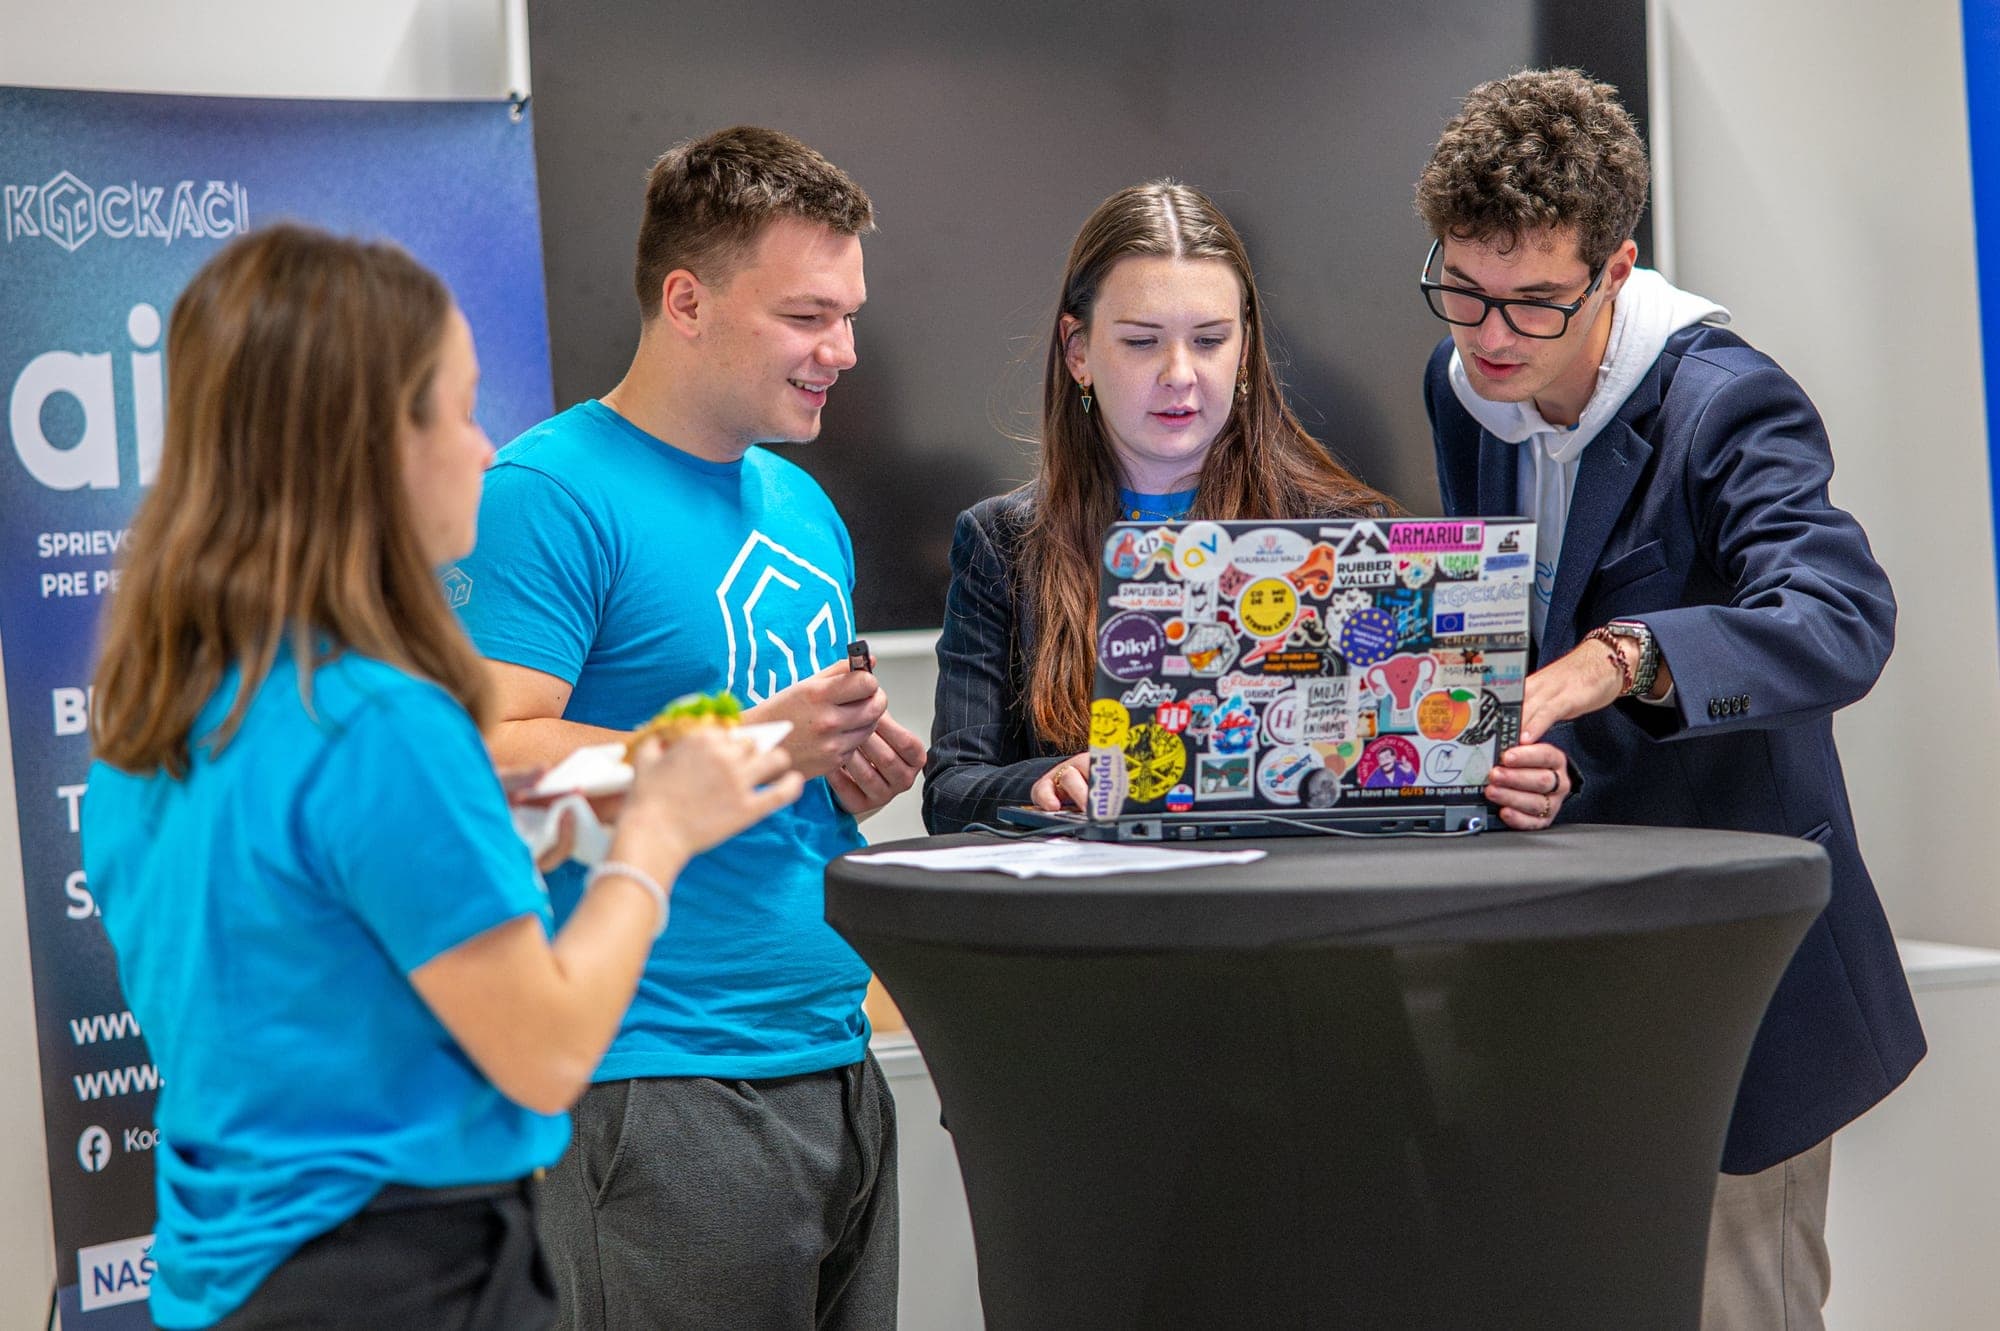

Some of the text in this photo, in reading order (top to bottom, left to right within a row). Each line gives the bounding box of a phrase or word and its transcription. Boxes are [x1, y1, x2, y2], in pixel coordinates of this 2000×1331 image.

[1337, 560, 1392, 574] RUBBER
[42, 571, 89, 598] PRE
[1339, 572, 1391, 586] VALLEY
[1274, 612, 1292, 630] LESS
[53, 686, 96, 737] B
[1347, 786, 1478, 798] we have the GUTS to speak out
[65, 870, 101, 920] S
